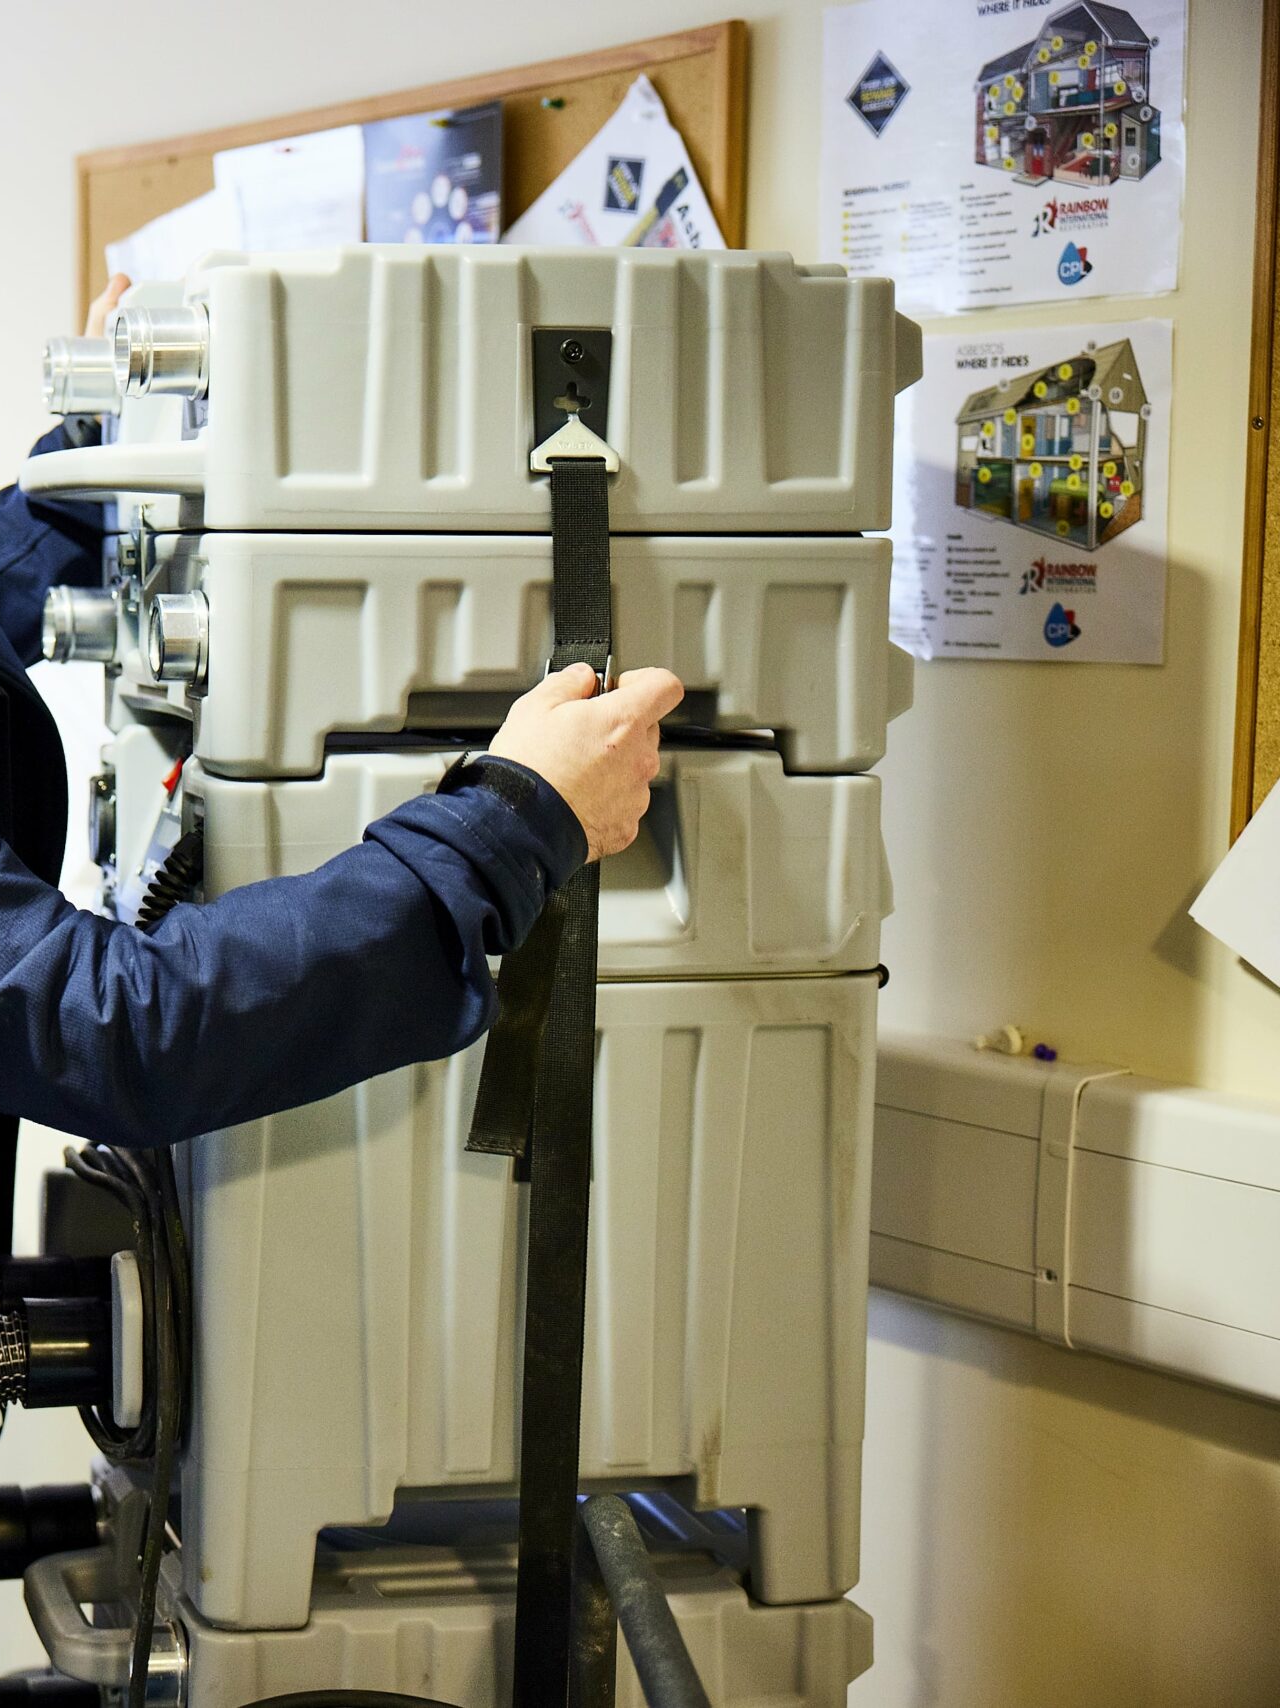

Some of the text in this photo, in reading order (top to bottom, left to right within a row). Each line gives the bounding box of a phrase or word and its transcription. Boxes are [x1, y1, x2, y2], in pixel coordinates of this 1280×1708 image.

[977, 2, 1009, 16] WHERE
[1060, 198, 1109, 214] RAINBOW
[1060, 212, 1108, 224] INTERNATIONAL
[1060, 260, 1088, 278] CPL
[956, 357, 987, 370] WHERE
[1001, 354, 1029, 368] HIDES
[1046, 563, 1098, 577] RAINBOW
[1046, 623, 1074, 638] CPL
